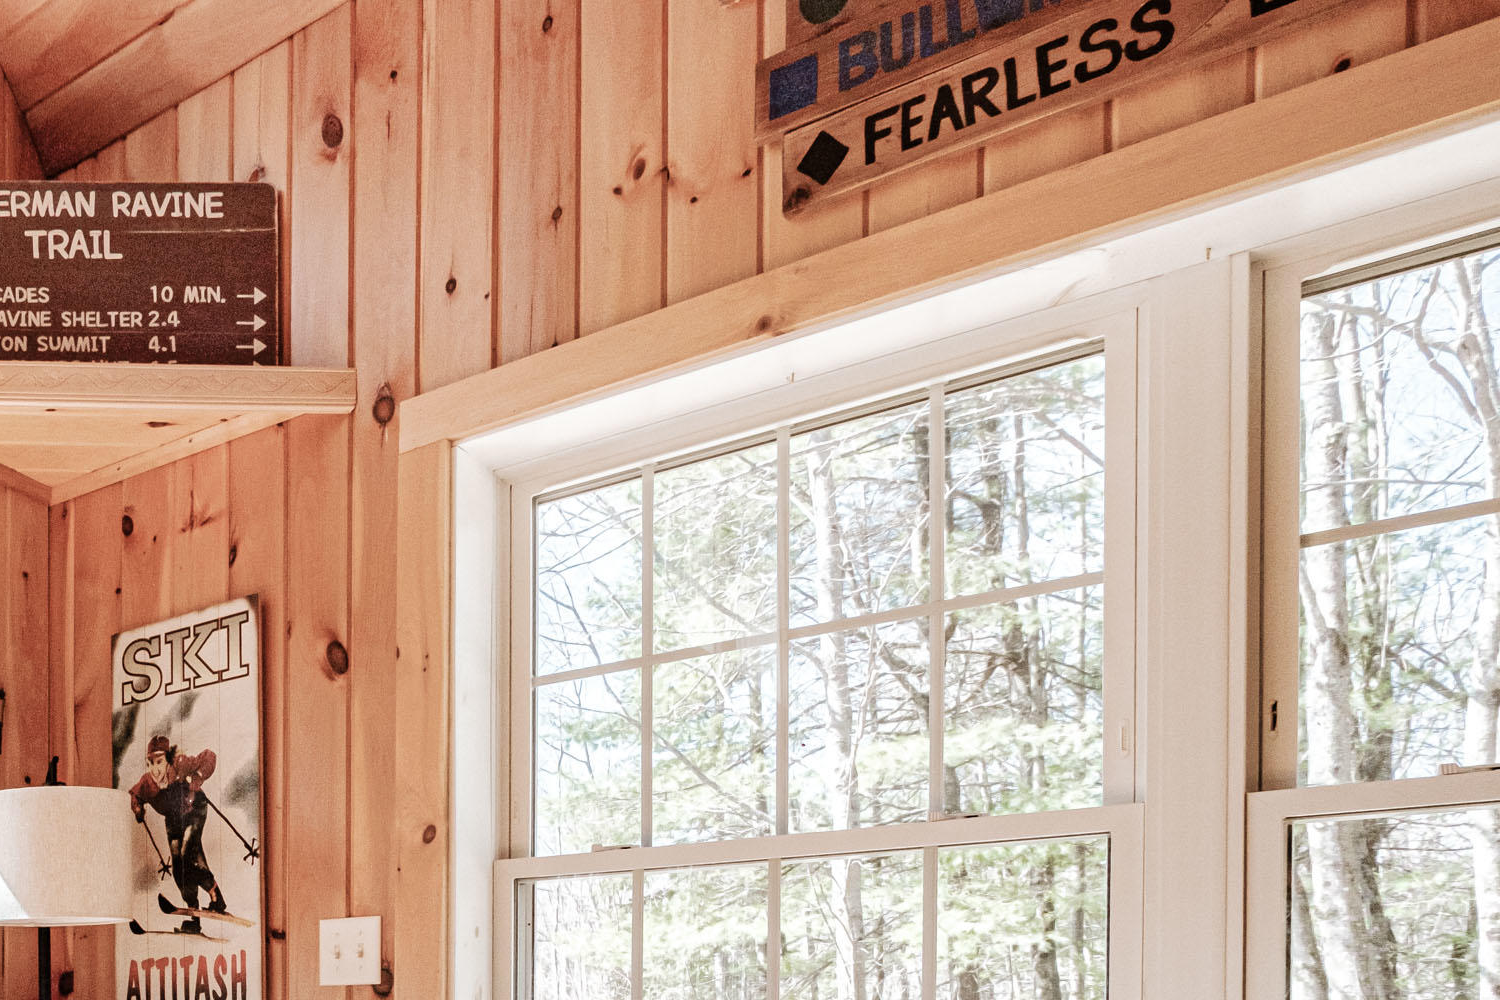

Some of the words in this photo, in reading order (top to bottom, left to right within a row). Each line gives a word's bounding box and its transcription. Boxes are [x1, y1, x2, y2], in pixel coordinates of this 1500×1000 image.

[864, 0, 1176, 165] FEARLESS
[112, 191, 224, 219] RAVINE
[24, 229, 123, 260] TRAIL
[150, 285, 174, 302] 10
[183, 286, 226, 303] MIN.
[61, 310, 143, 328] SHELTER
[148, 310, 180, 328] 2.4
[37, 335, 111, 353] SUMMIT
[149, 335, 177, 352] 4.1
[122, 610, 250, 706] SKI
